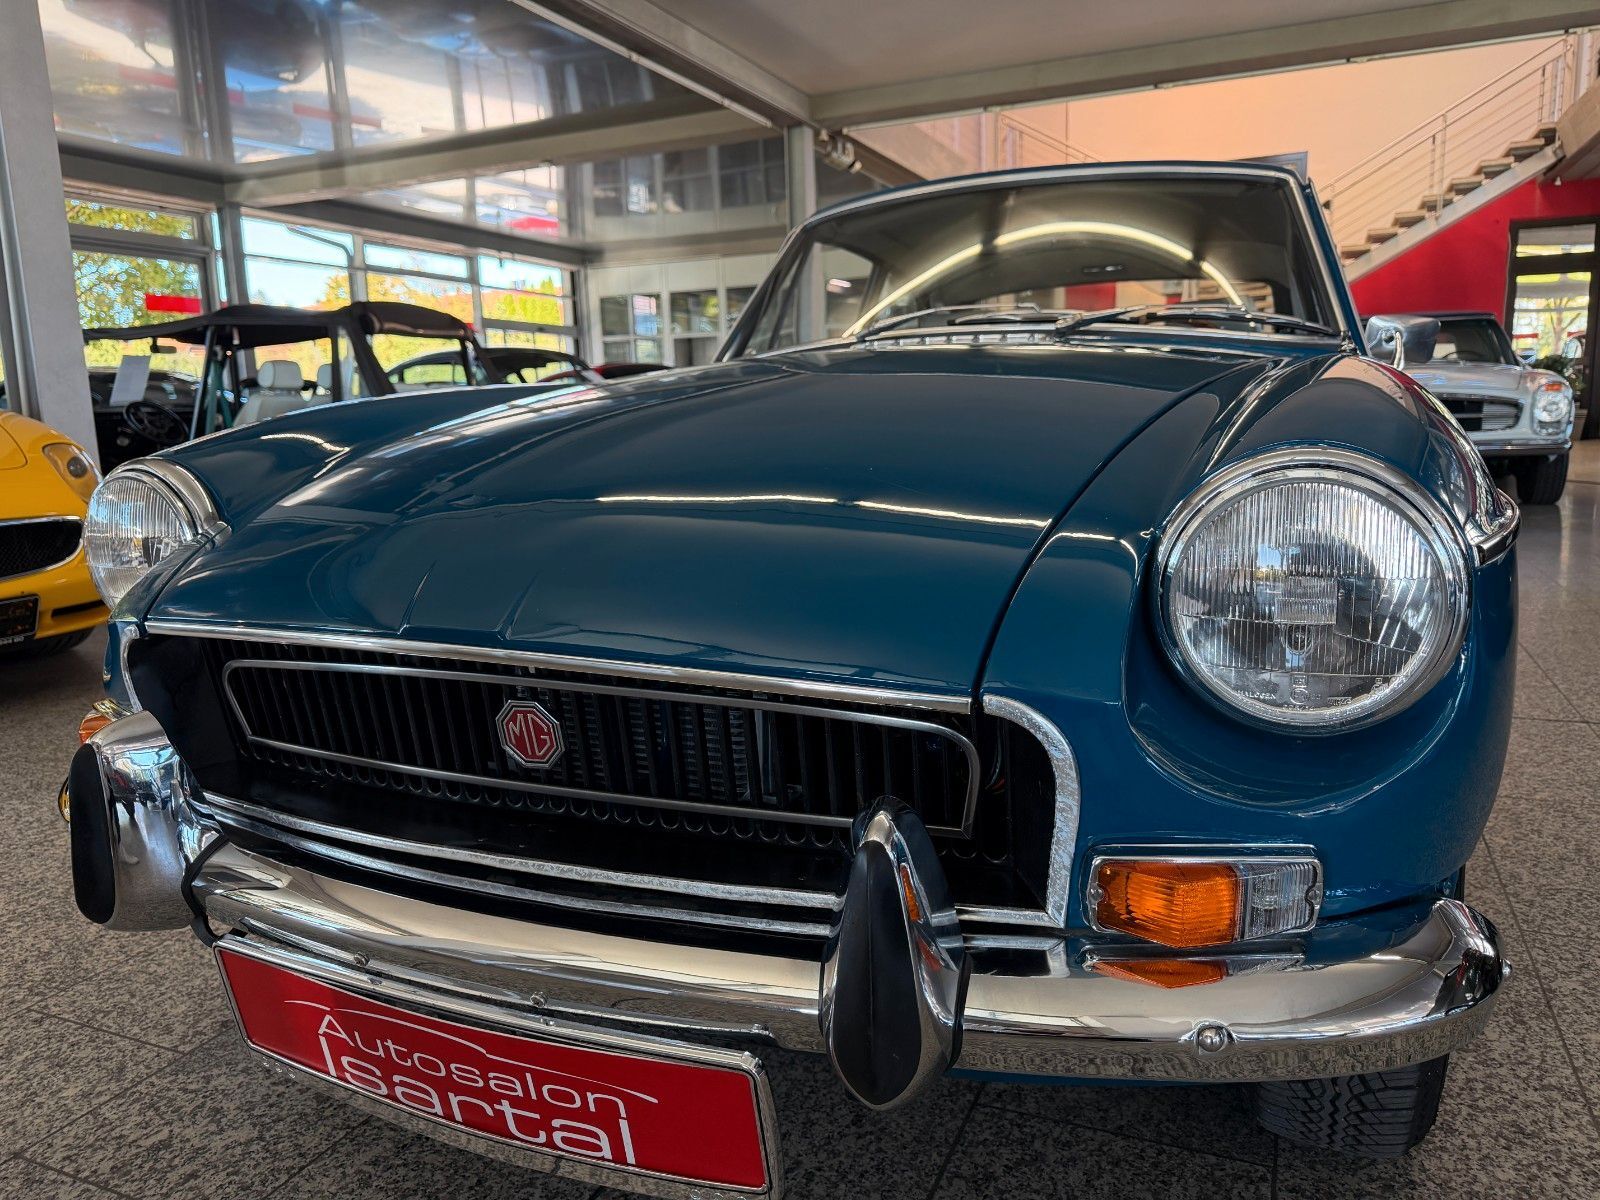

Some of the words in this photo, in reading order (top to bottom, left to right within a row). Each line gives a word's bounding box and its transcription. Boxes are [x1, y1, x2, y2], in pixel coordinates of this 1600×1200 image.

[508, 713, 551, 756] MG
[317, 1014, 627, 1118] Autosalon
[318, 1035, 636, 1165] Isartal
